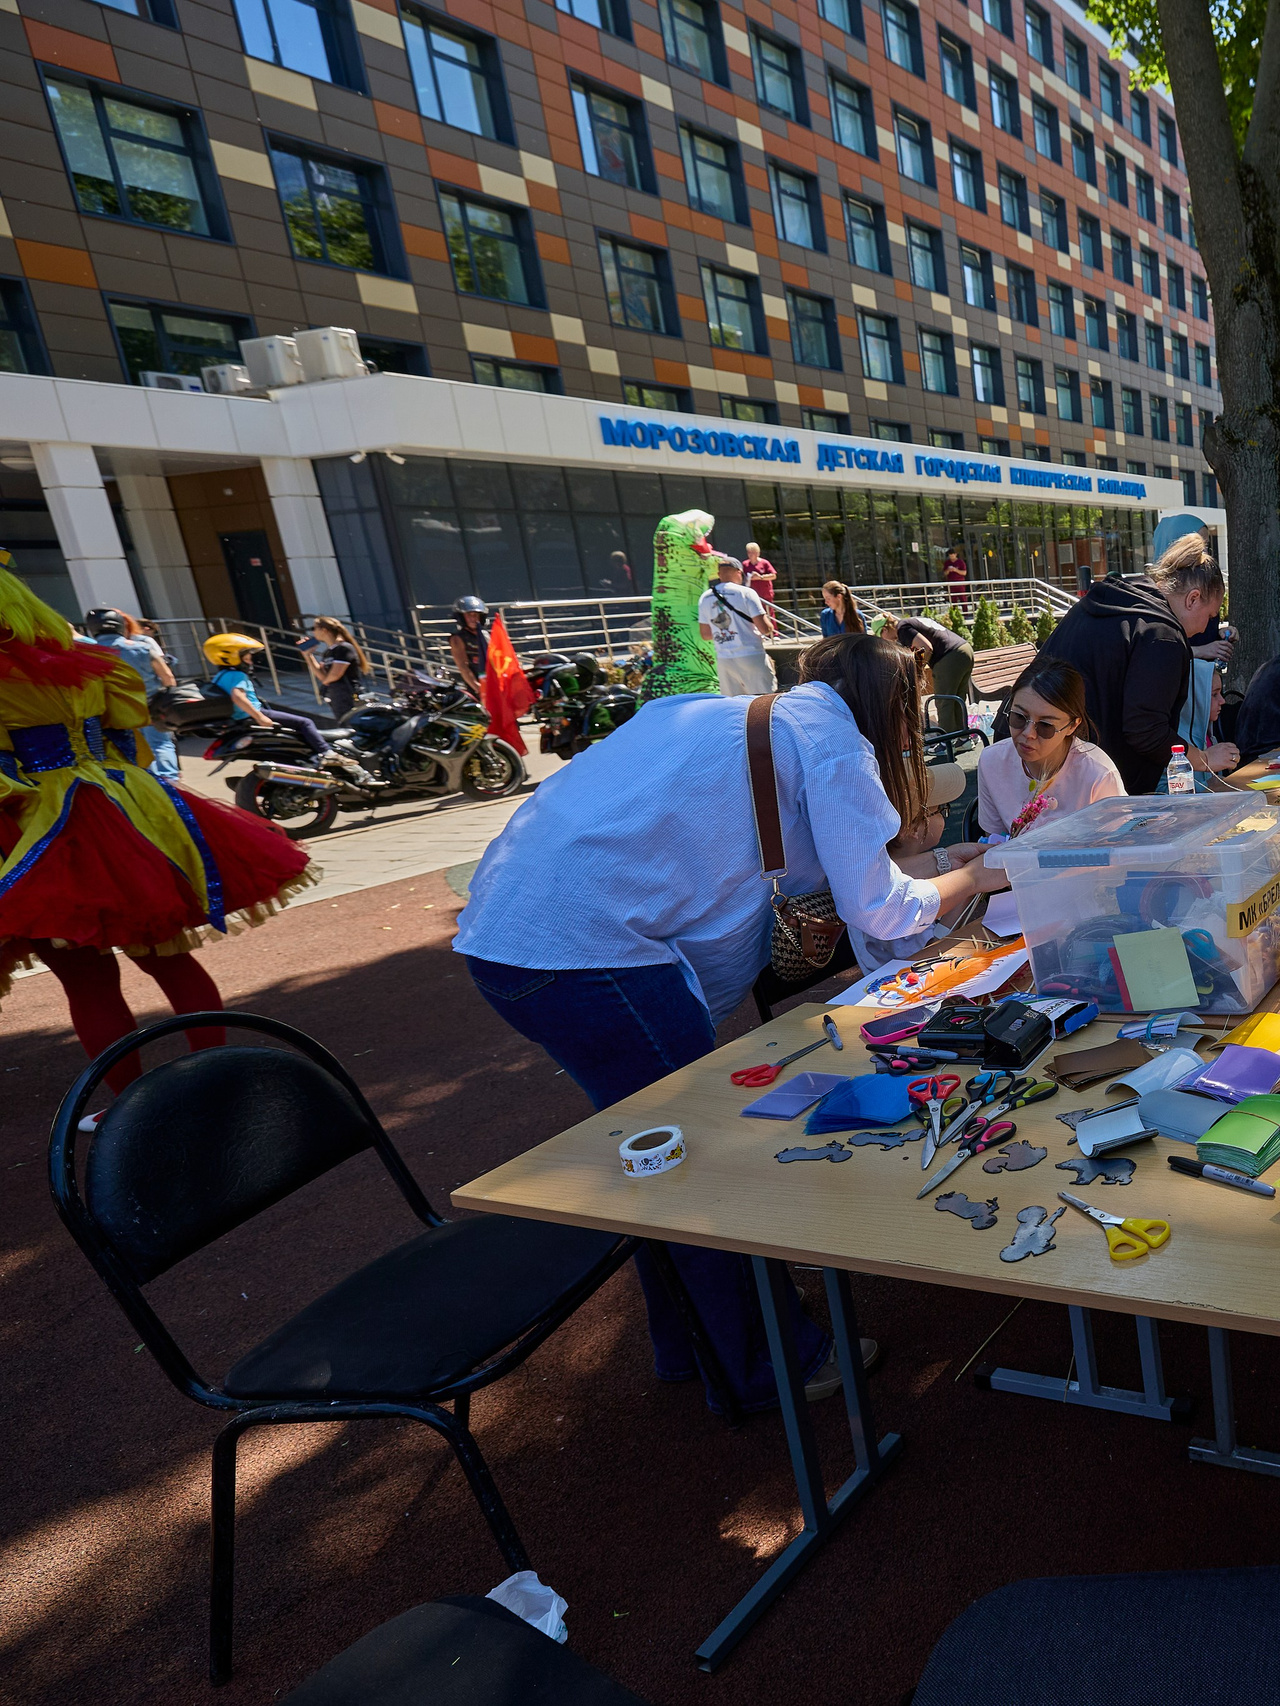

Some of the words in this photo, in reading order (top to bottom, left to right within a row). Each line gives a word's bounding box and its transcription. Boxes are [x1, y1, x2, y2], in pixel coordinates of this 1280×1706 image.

[599, 416, 801, 463] МОРОЗОВСКАЯ
[816, 443, 904, 473] ДЕТСКАЯ
[914, 455, 1002, 483] ГОРОДСКАЯ
[1009, 467, 1092, 492] КЛИНИЧЕСКАЯ
[1097, 477, 1147, 500] БОЛЬНИЦА
[1239, 903, 1257, 930] МК
